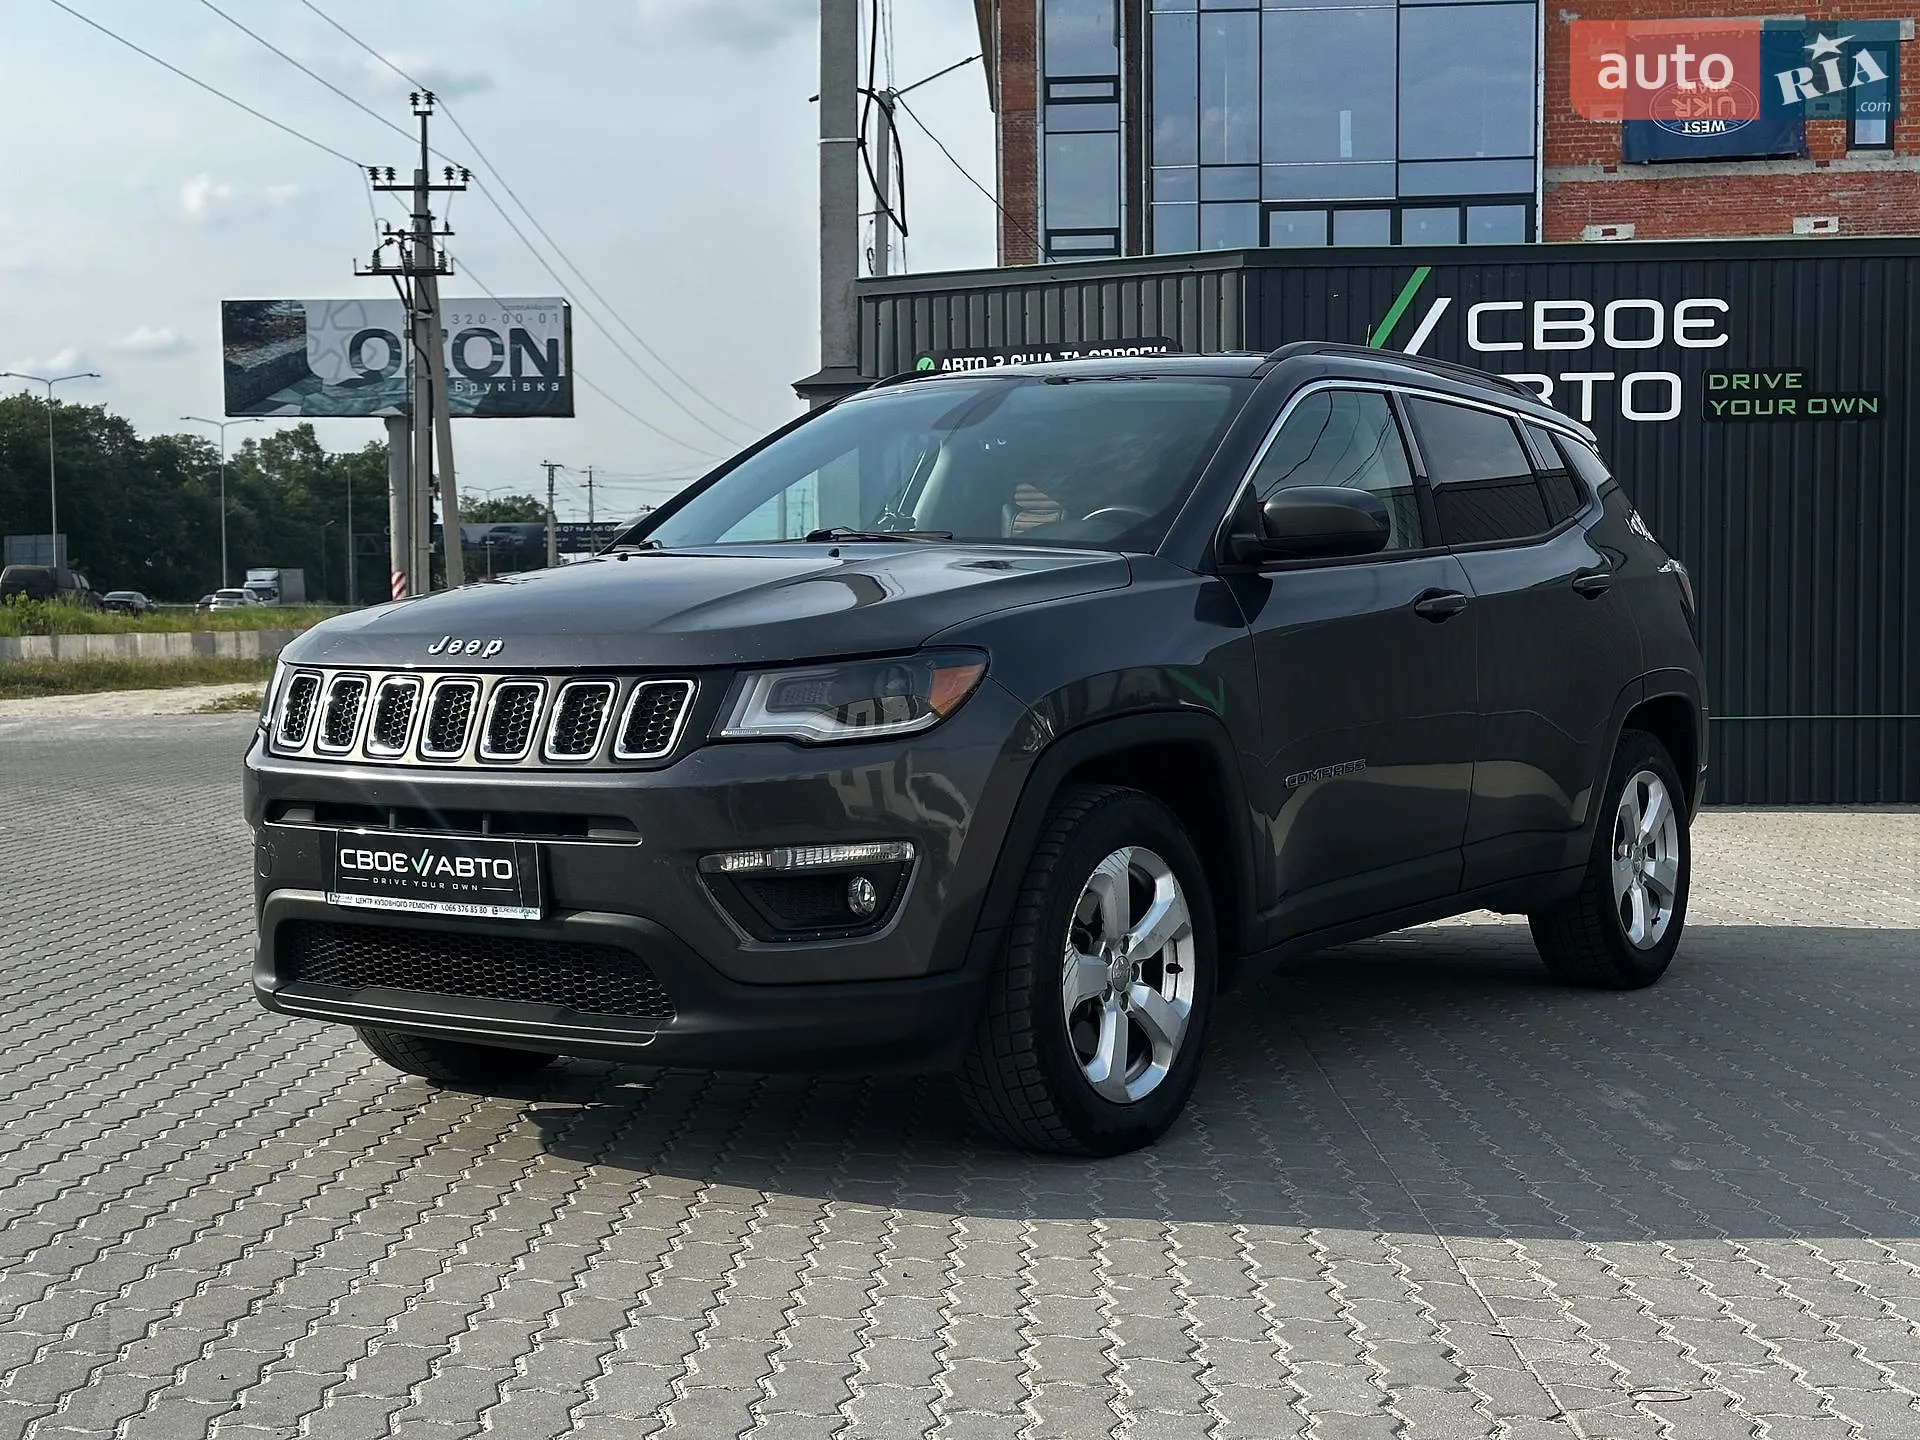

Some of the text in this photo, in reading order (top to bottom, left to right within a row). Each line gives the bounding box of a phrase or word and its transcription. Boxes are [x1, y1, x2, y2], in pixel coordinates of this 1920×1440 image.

[1671, 96, 1736, 117] UKR
[1682, 120, 1726, 133] WEST
[349, 327, 559, 379] OON
[455, 380, 560, 394] Бруківка
[1709, 373, 1803, 390] DRIVE
[1709, 398, 1878, 416] YOUR OWN
[427, 635, 504, 659] Jeep
[435, 855, 513, 880] АВТО
[372, 877, 408, 886] DRIVE
[413, 880, 445, 889] YOUR
